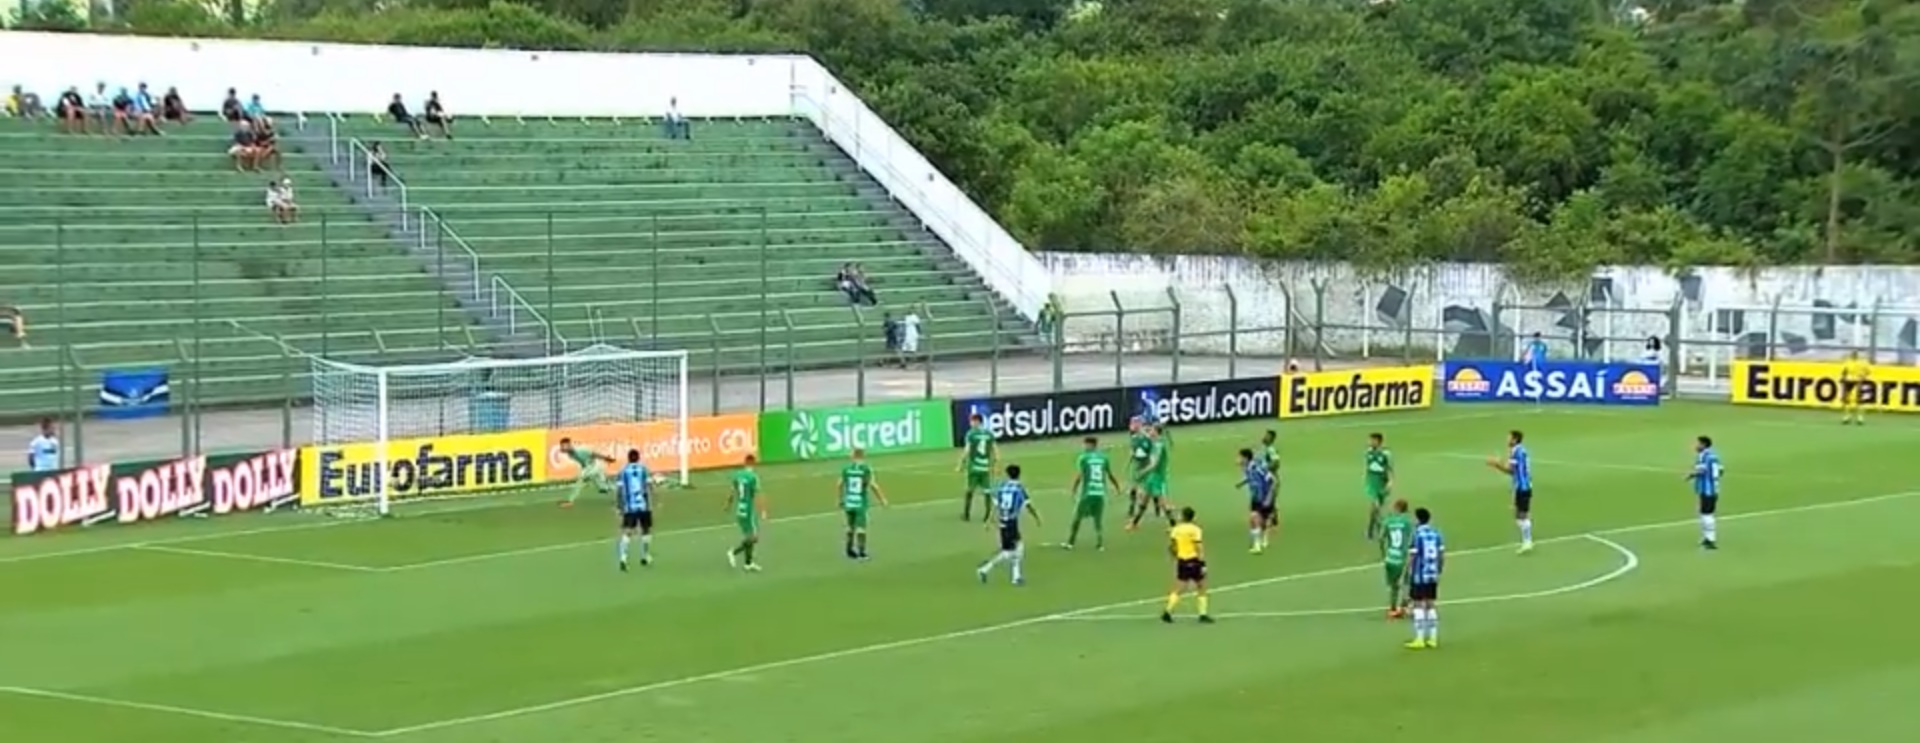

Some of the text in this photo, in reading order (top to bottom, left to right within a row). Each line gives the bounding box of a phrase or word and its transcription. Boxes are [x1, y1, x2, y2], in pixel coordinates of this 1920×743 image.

[1290, 374, 1423, 412] Eurofarma
[644, 437, 711, 458] confrto
[826, 409, 921, 450] Sicredi
[15, 464, 111, 534] DOLLY
[117, 456, 207, 523] DOLLY
[213, 448, 297, 513] DOLLY
